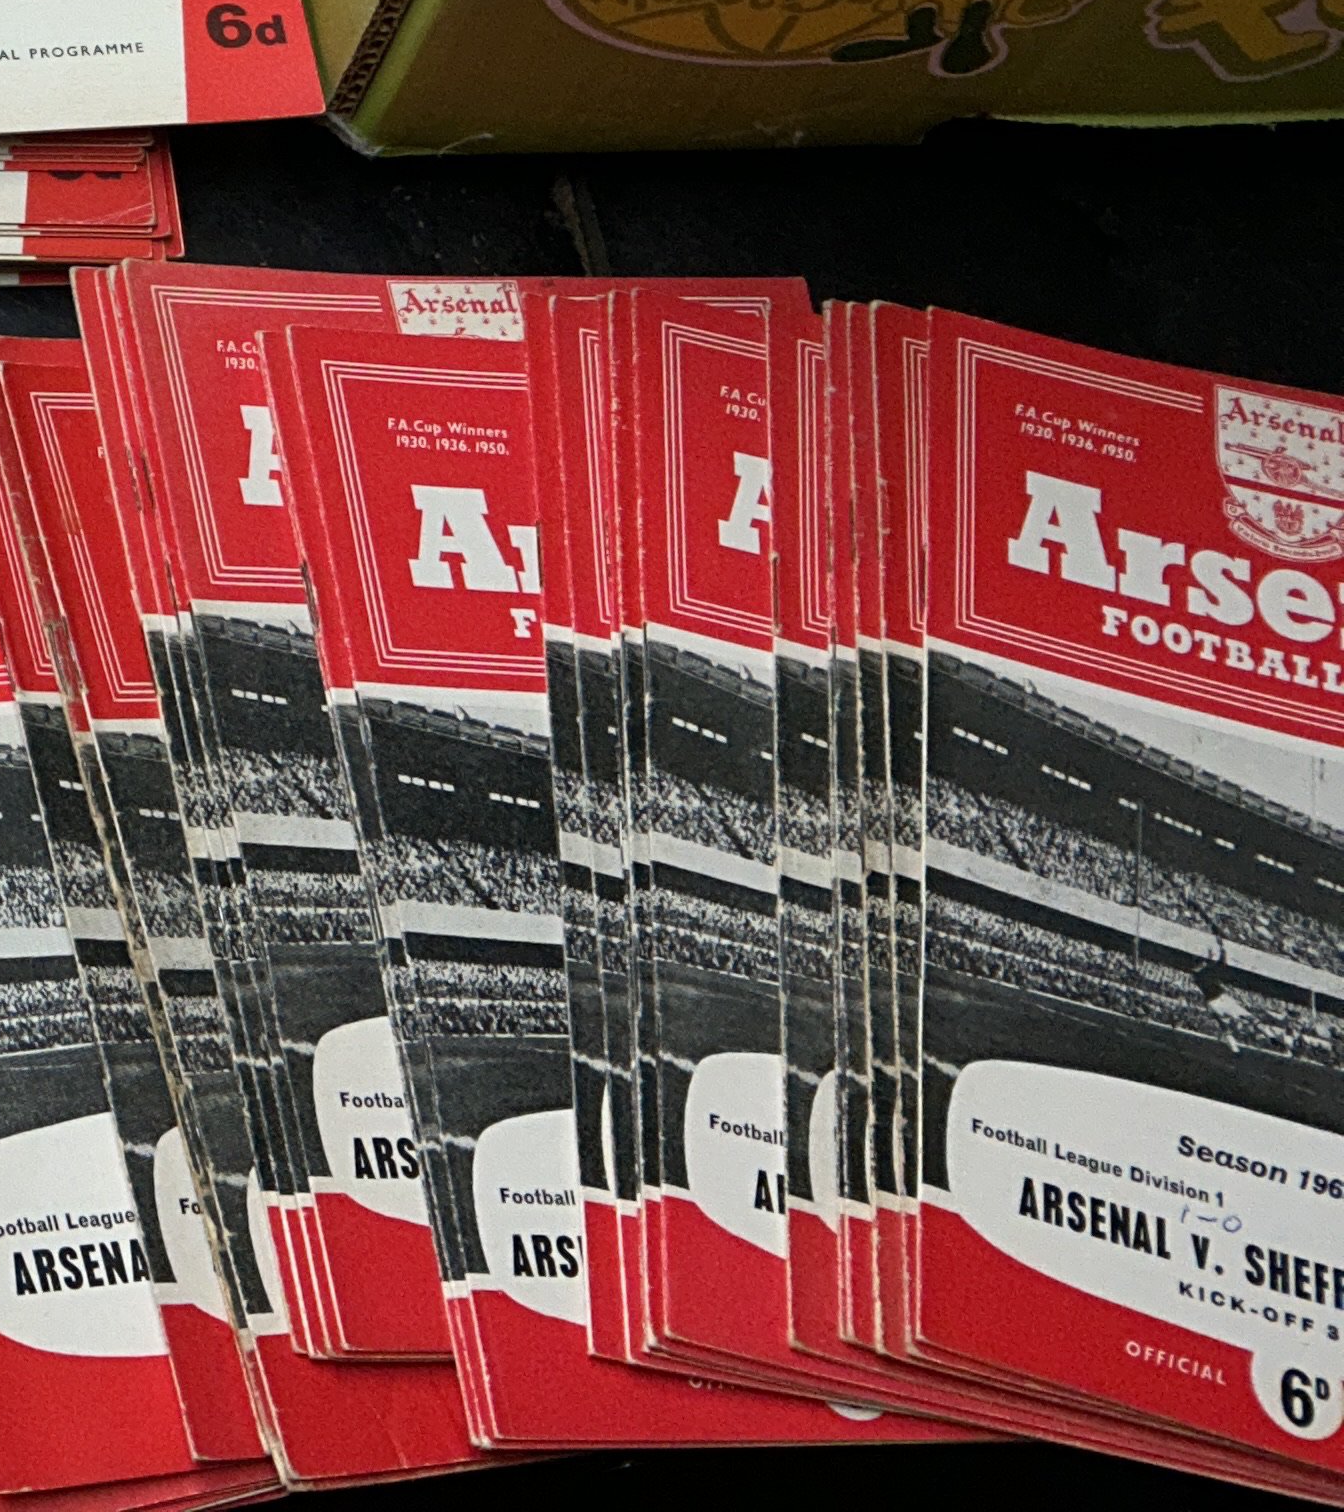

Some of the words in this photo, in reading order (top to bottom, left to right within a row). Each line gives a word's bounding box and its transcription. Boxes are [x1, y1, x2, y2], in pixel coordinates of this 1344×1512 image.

[204, 3, 288, 49] 6d
[28, 42, 146, 60] PROGRAMME
[446, 421, 509, 439] Winners
[971, 1118, 1048, 1156] Football
[1054, 1140, 1125, 1178] League
[1129, 1165, 1210, 1205] Division
[1177, 1135, 1291, 1186] Season
[499, 1185, 576, 1209] Football
[1018, 1176, 1173, 1261] ARSENAL
[1178, 1280, 1316, 1334] KICK-OFF
[1125, 1340, 1228, 1386] OFFICIAL
